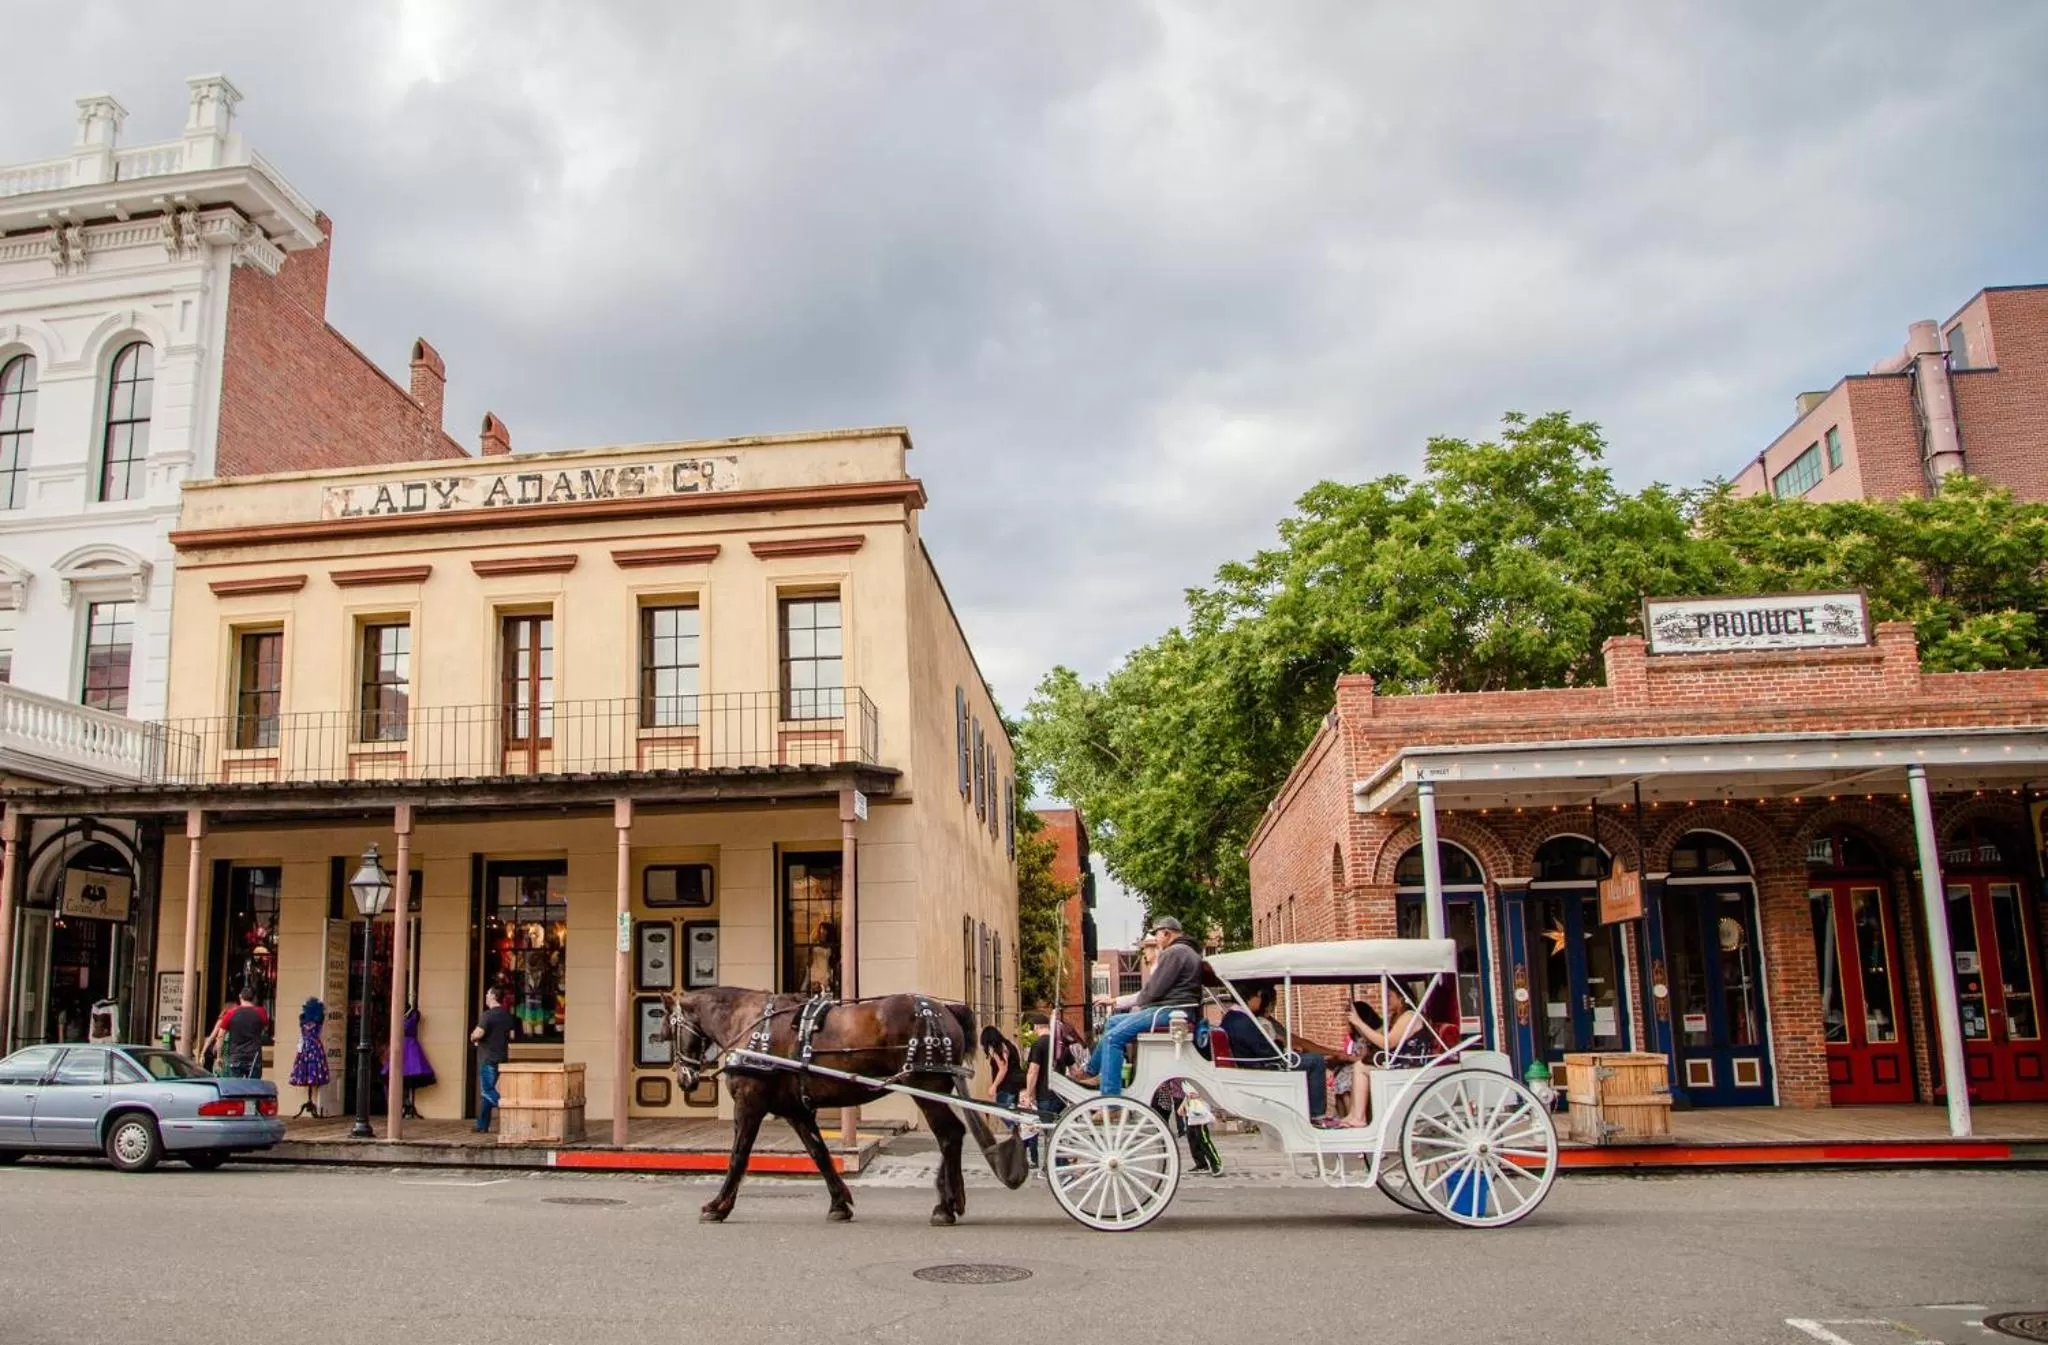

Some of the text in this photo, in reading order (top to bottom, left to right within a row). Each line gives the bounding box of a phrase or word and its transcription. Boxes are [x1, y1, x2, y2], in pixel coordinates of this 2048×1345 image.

[341, 477, 460, 517] LADY
[1696, 608, 1815, 638] PRODUCE
[1417, 769, 1424, 780] K
